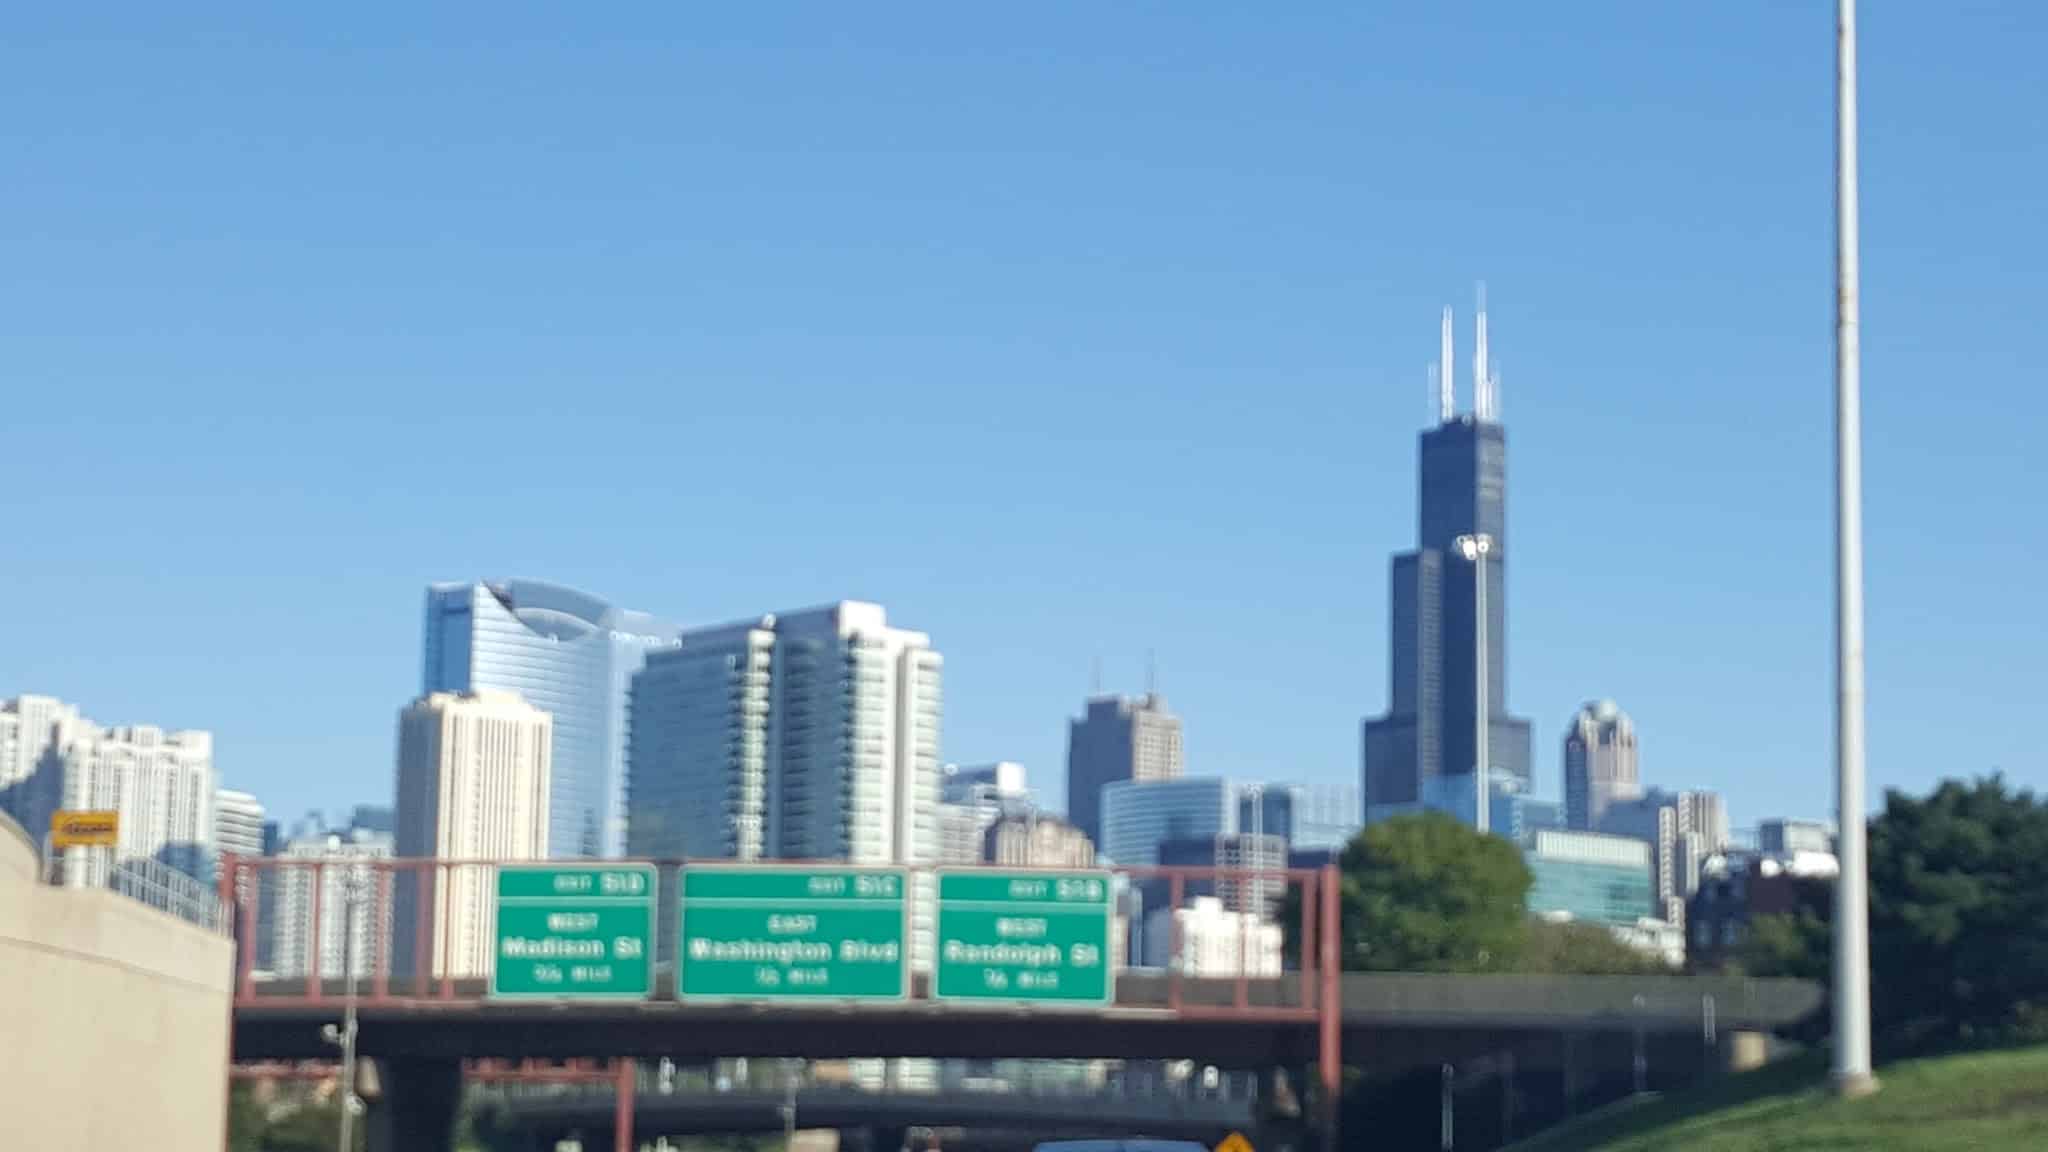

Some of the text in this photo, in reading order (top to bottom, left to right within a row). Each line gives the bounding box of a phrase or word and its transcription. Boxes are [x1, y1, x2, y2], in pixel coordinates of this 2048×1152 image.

[502, 936, 642, 960] Madison St
[689, 938, 898, 965] Washington Blvd
[944, 940, 1098, 967] Randolph St
